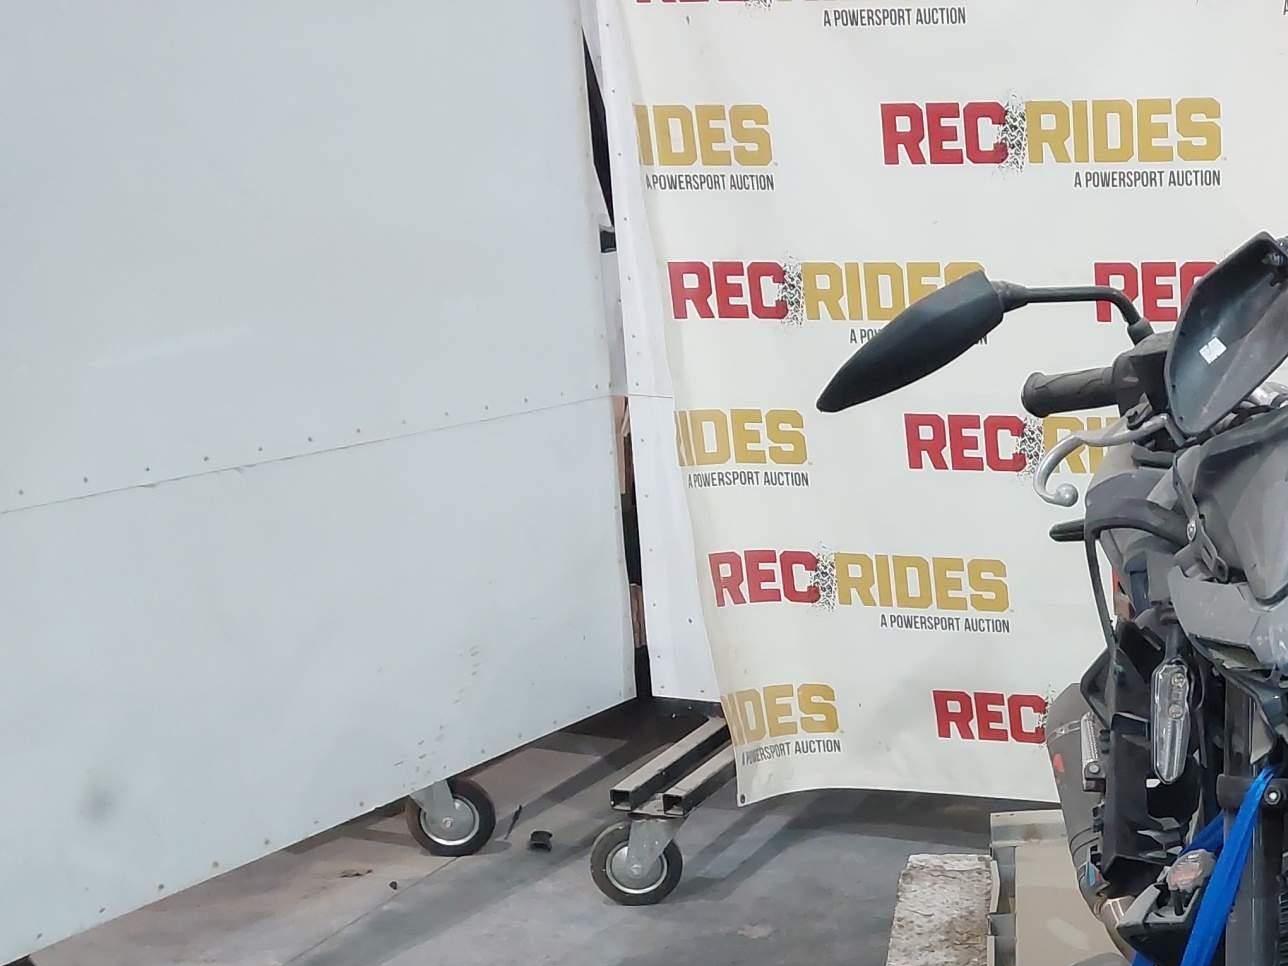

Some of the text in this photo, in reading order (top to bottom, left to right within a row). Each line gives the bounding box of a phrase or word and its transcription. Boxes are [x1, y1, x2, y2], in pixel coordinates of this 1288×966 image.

[824, 7, 966, 27] A POWERSPORT AUCTION
[633, 104, 773, 166] IDES
[881, 98, 1222, 165] REC RIDES
[652, 174, 725, 190] POWERSPORT
[730, 174, 774, 190] AUCTION
[1074, 170, 1220, 188] A POWERSPORT AUCTION
[668, 261, 984, 321] REC RIDE
[904, 413, 1028, 472] REC
[693, 471, 760, 488] POWERSPORT
[764, 472, 809, 487] AUCTION
[709, 550, 1009, 612] REC RIDES
[881, 614, 1009, 633] A POWERSPORT AUCTION
[932, 689, 1046, 744] REC
[795, 739, 841, 754] AUCTION
